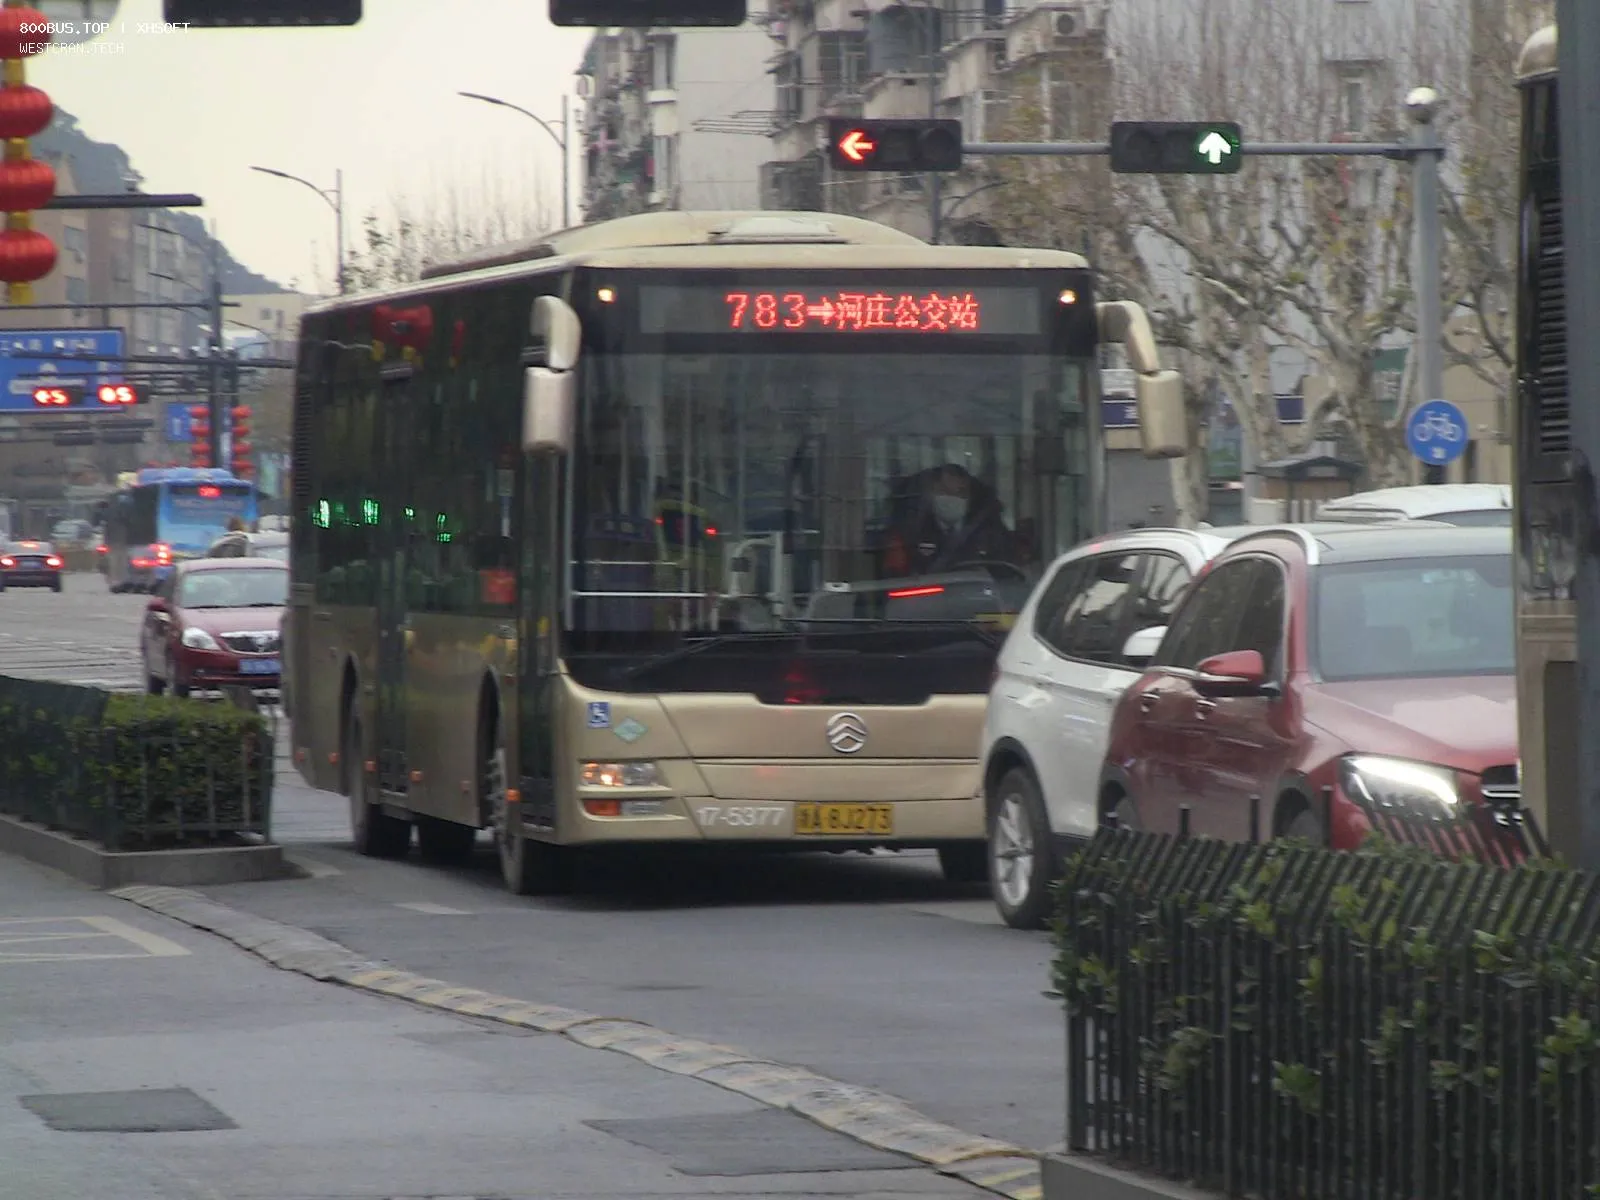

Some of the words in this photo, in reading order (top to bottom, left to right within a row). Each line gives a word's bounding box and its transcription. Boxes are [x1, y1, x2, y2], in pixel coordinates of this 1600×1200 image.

[726, 293, 805, 328] 783
[835, 292, 979, 330] 河庄公交站
[696, 806, 785, 826] 17-5377
